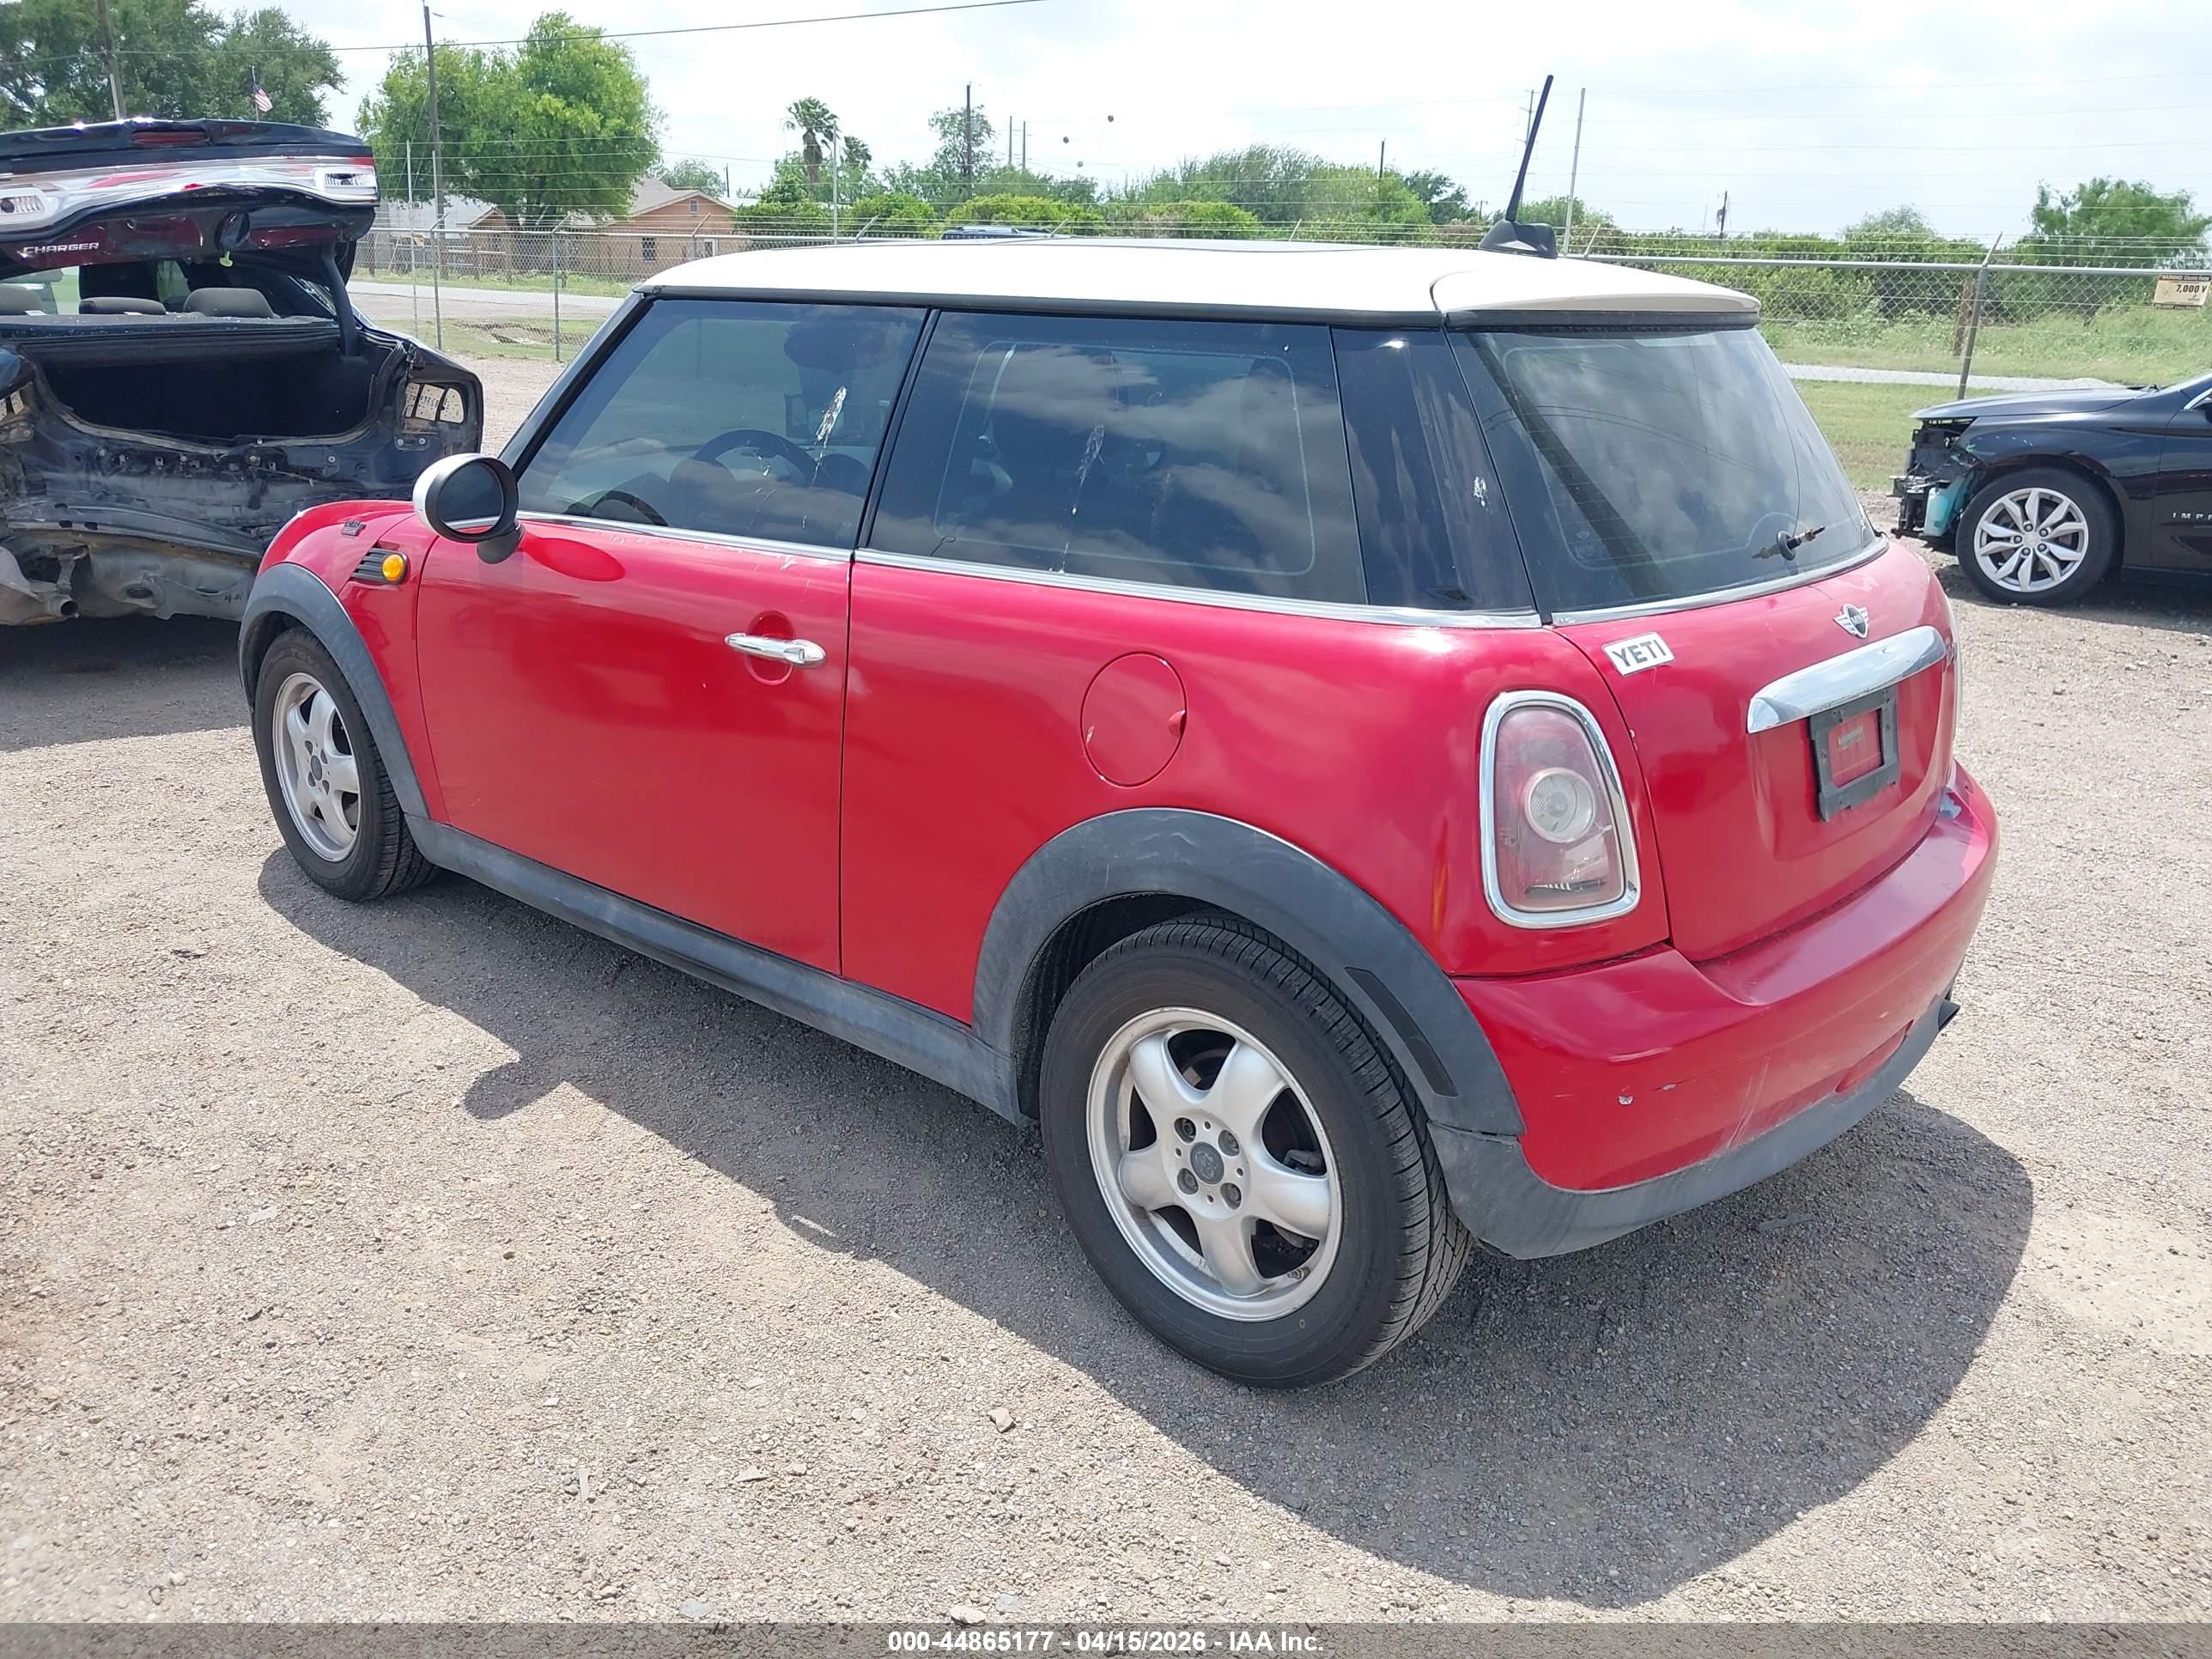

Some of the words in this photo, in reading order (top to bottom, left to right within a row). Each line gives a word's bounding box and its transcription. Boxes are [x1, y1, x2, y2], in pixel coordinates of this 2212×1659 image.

[22, 242, 100, 255] CHARGER
[2176, 284, 2199, 293] 7,000
[1611, 639, 1667, 667] YETI
